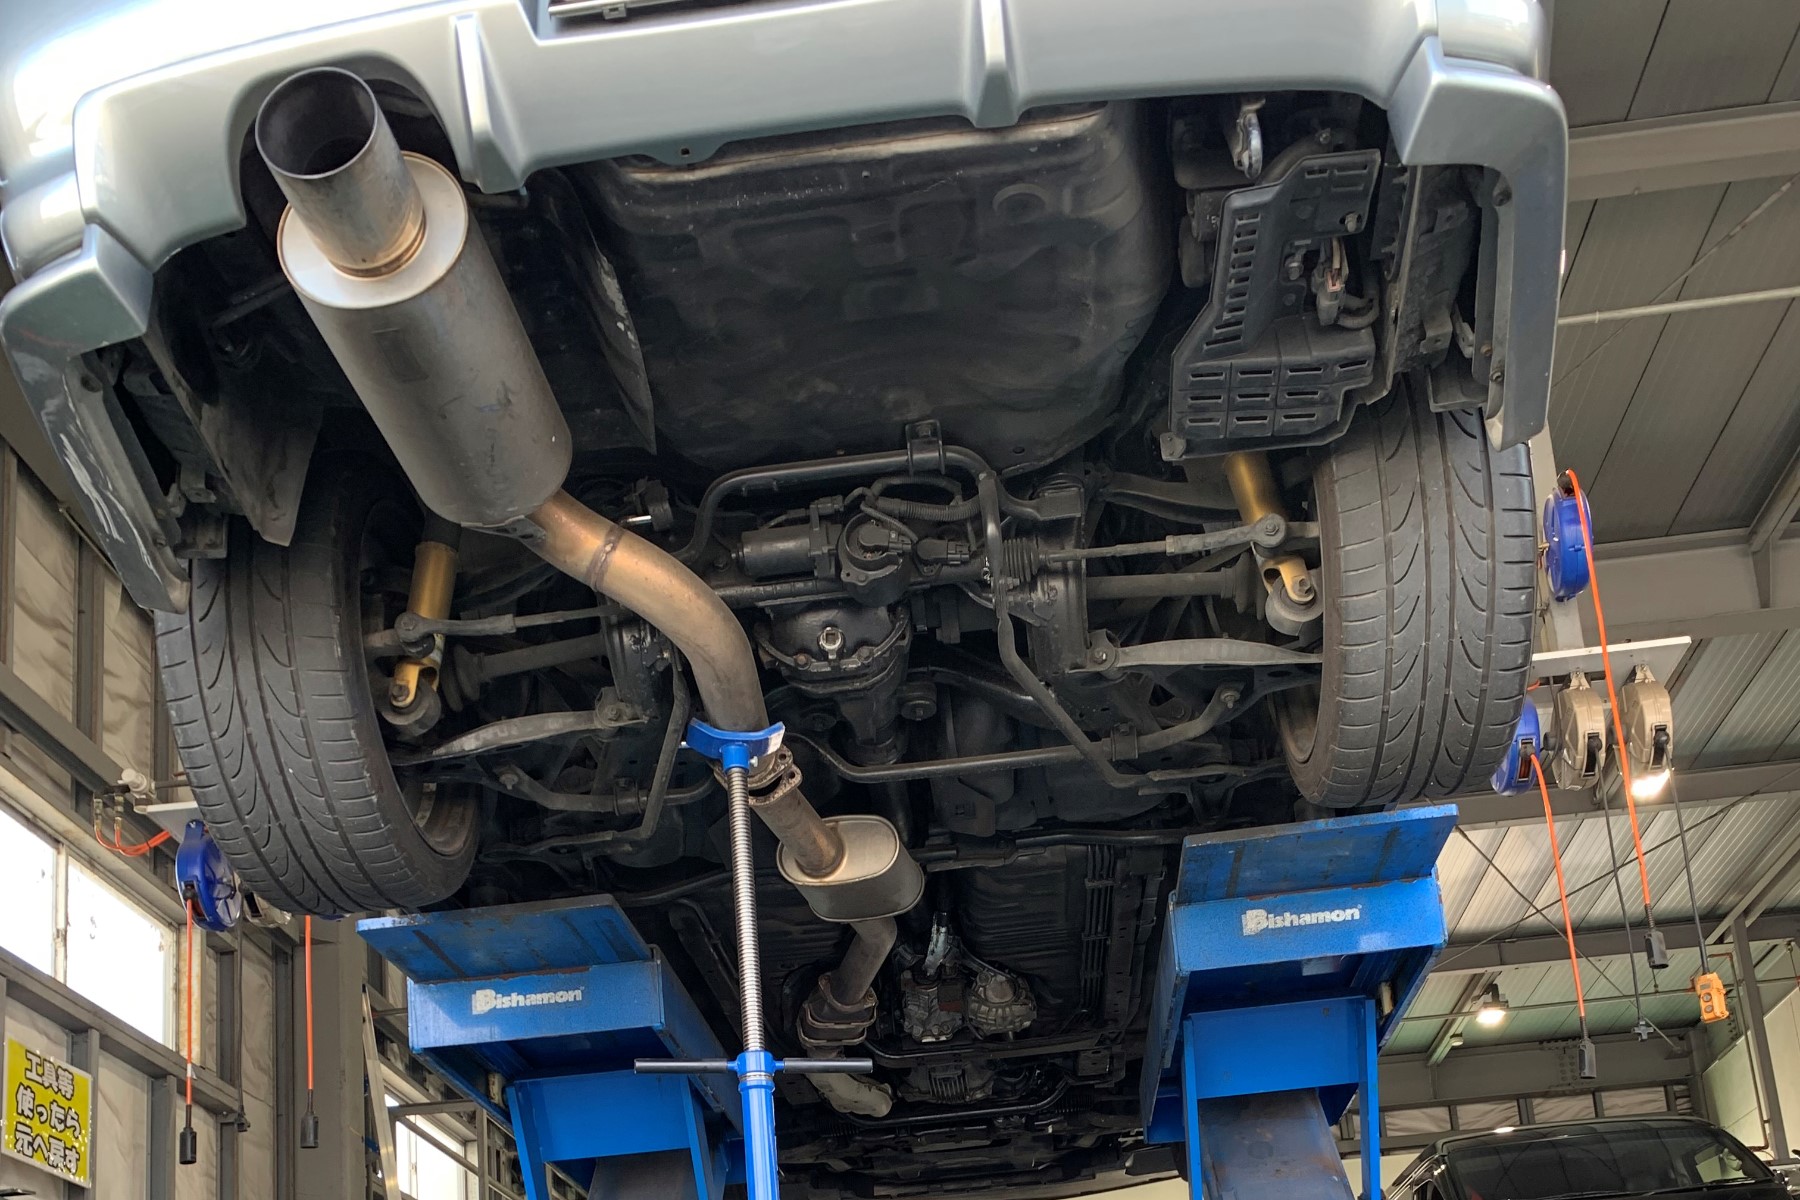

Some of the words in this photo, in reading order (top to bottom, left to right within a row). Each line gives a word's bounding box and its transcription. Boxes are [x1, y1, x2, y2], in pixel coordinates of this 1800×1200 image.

[24, 1049, 74, 1100] 工具等
[16, 1082, 82, 1138] 使ったら
[14, 1121, 80, 1175] 元へ戻す
